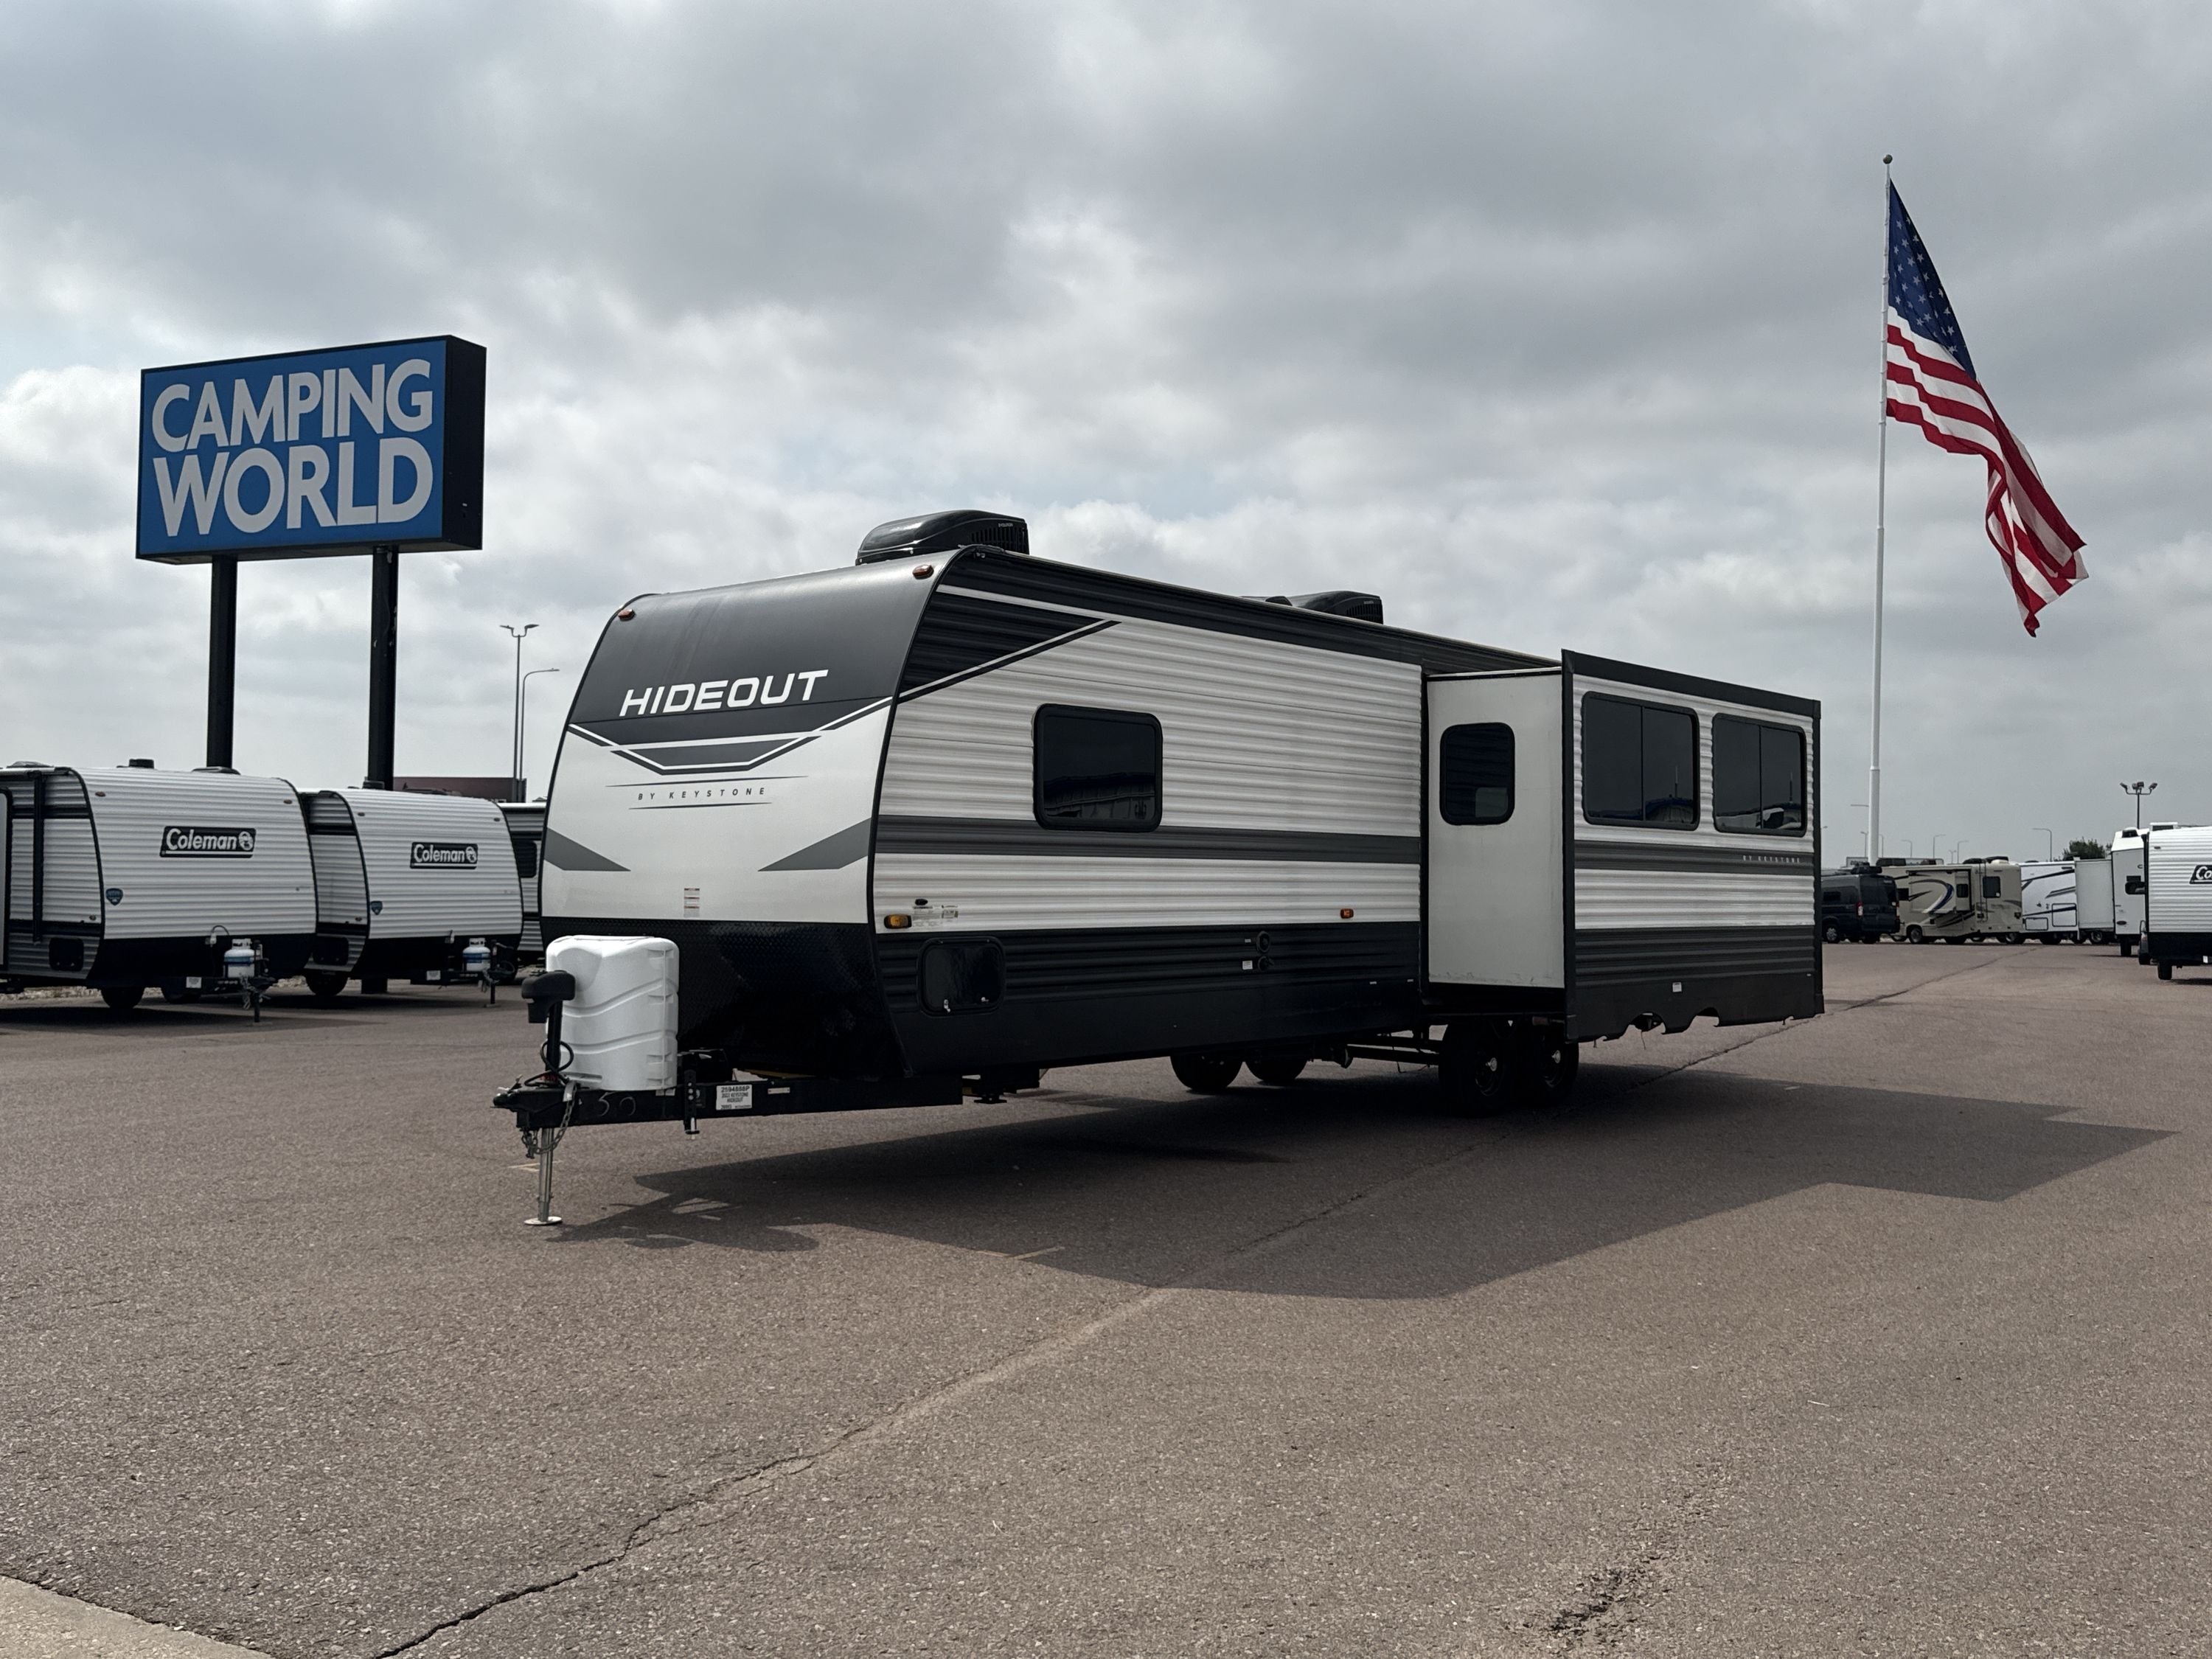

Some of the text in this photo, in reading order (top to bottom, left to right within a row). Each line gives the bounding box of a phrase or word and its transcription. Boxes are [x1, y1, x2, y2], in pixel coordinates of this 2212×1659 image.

[152, 358, 433, 453] CAMPING
[153, 437, 434, 537] WORLD
[619, 669, 829, 717] HIDEOUT
[669, 787, 765, 799] KEYSTONE
[166, 828, 237, 850] Coleman
[414, 844, 465, 863] Coleman
[2196, 866, 2212, 880] Co
